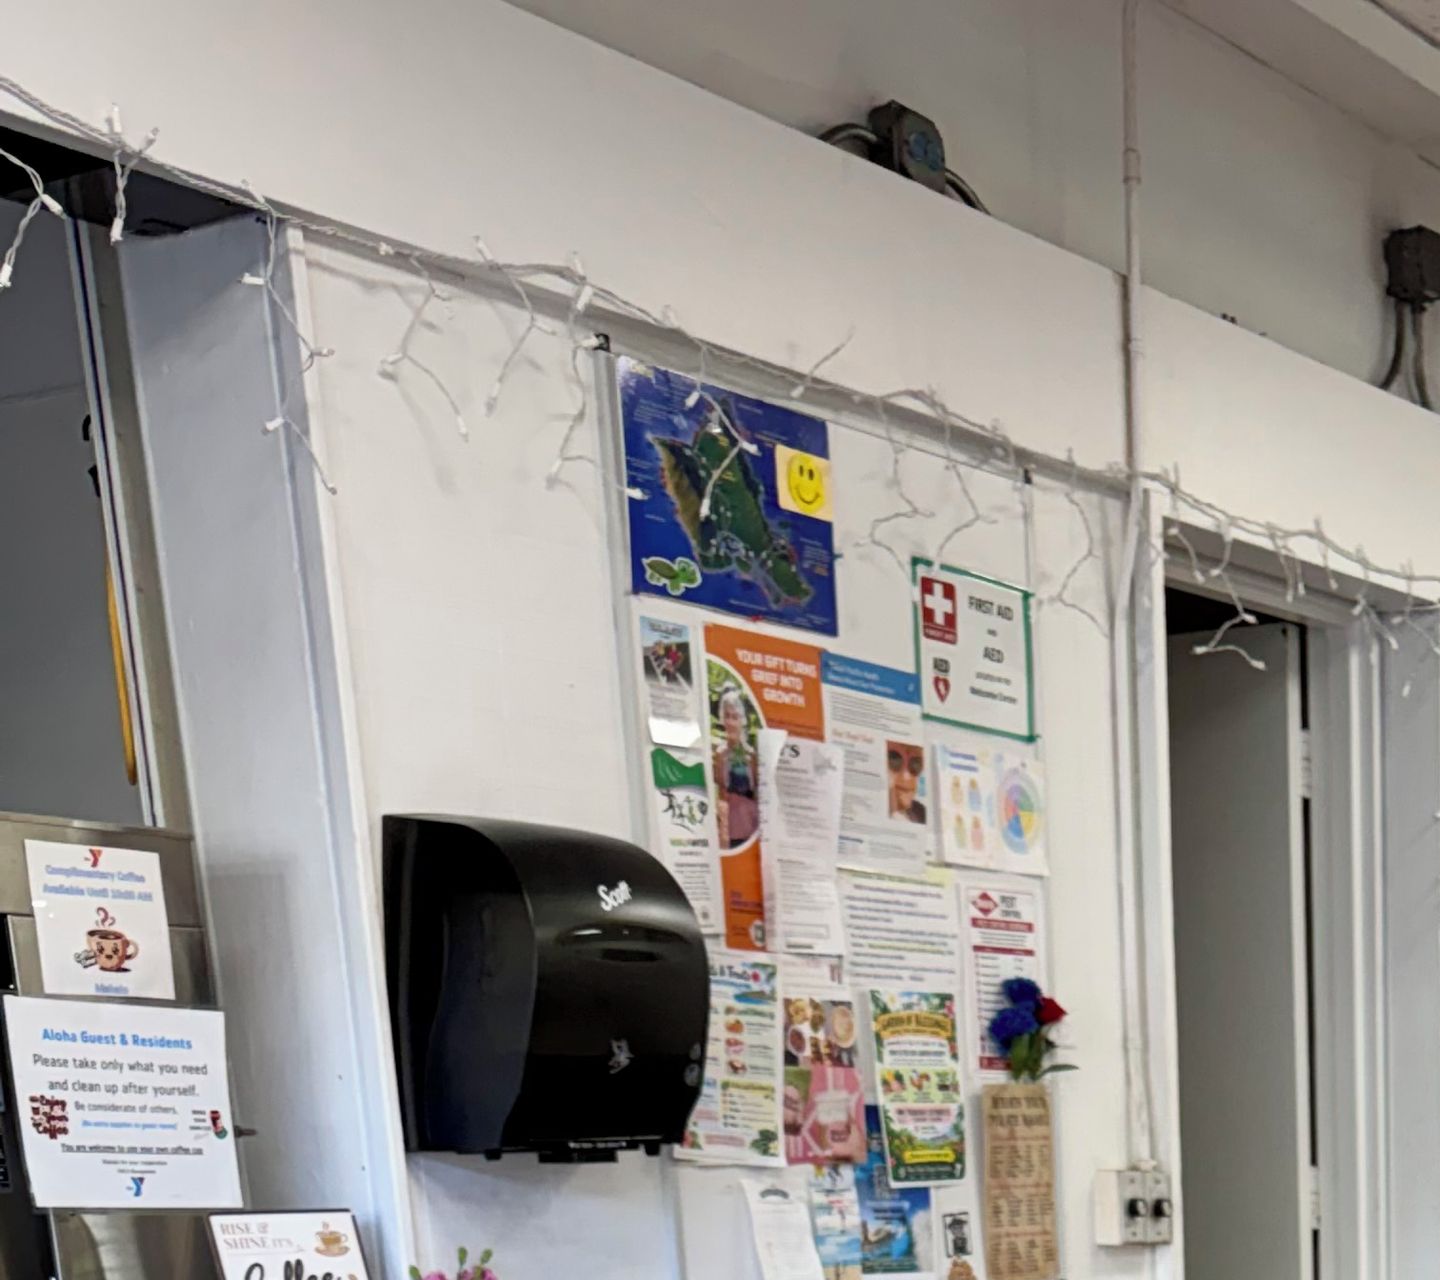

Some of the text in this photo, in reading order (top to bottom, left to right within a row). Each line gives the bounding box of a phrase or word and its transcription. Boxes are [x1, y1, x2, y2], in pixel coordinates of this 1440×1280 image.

[968, 596, 1014, 621] FIRST AID
[984, 646, 1004, 664] AED
[933, 657, 950, 674] AED
[42, 1028, 192, 1050] Aloha Guest & Residents
[32, 1054, 208, 1076] Please take only what you need
[48, 1080, 200, 1098] and clean up after yourself.
[75, 1100, 85, 1111] Be
[88, 1103, 136, 1113] considerate
[138, 1104, 148, 1114] of
[61, 1143, 74, 1152] You
[220, 1222, 254, 1236] RISE
[224, 1237, 268, 1250] SHINE
